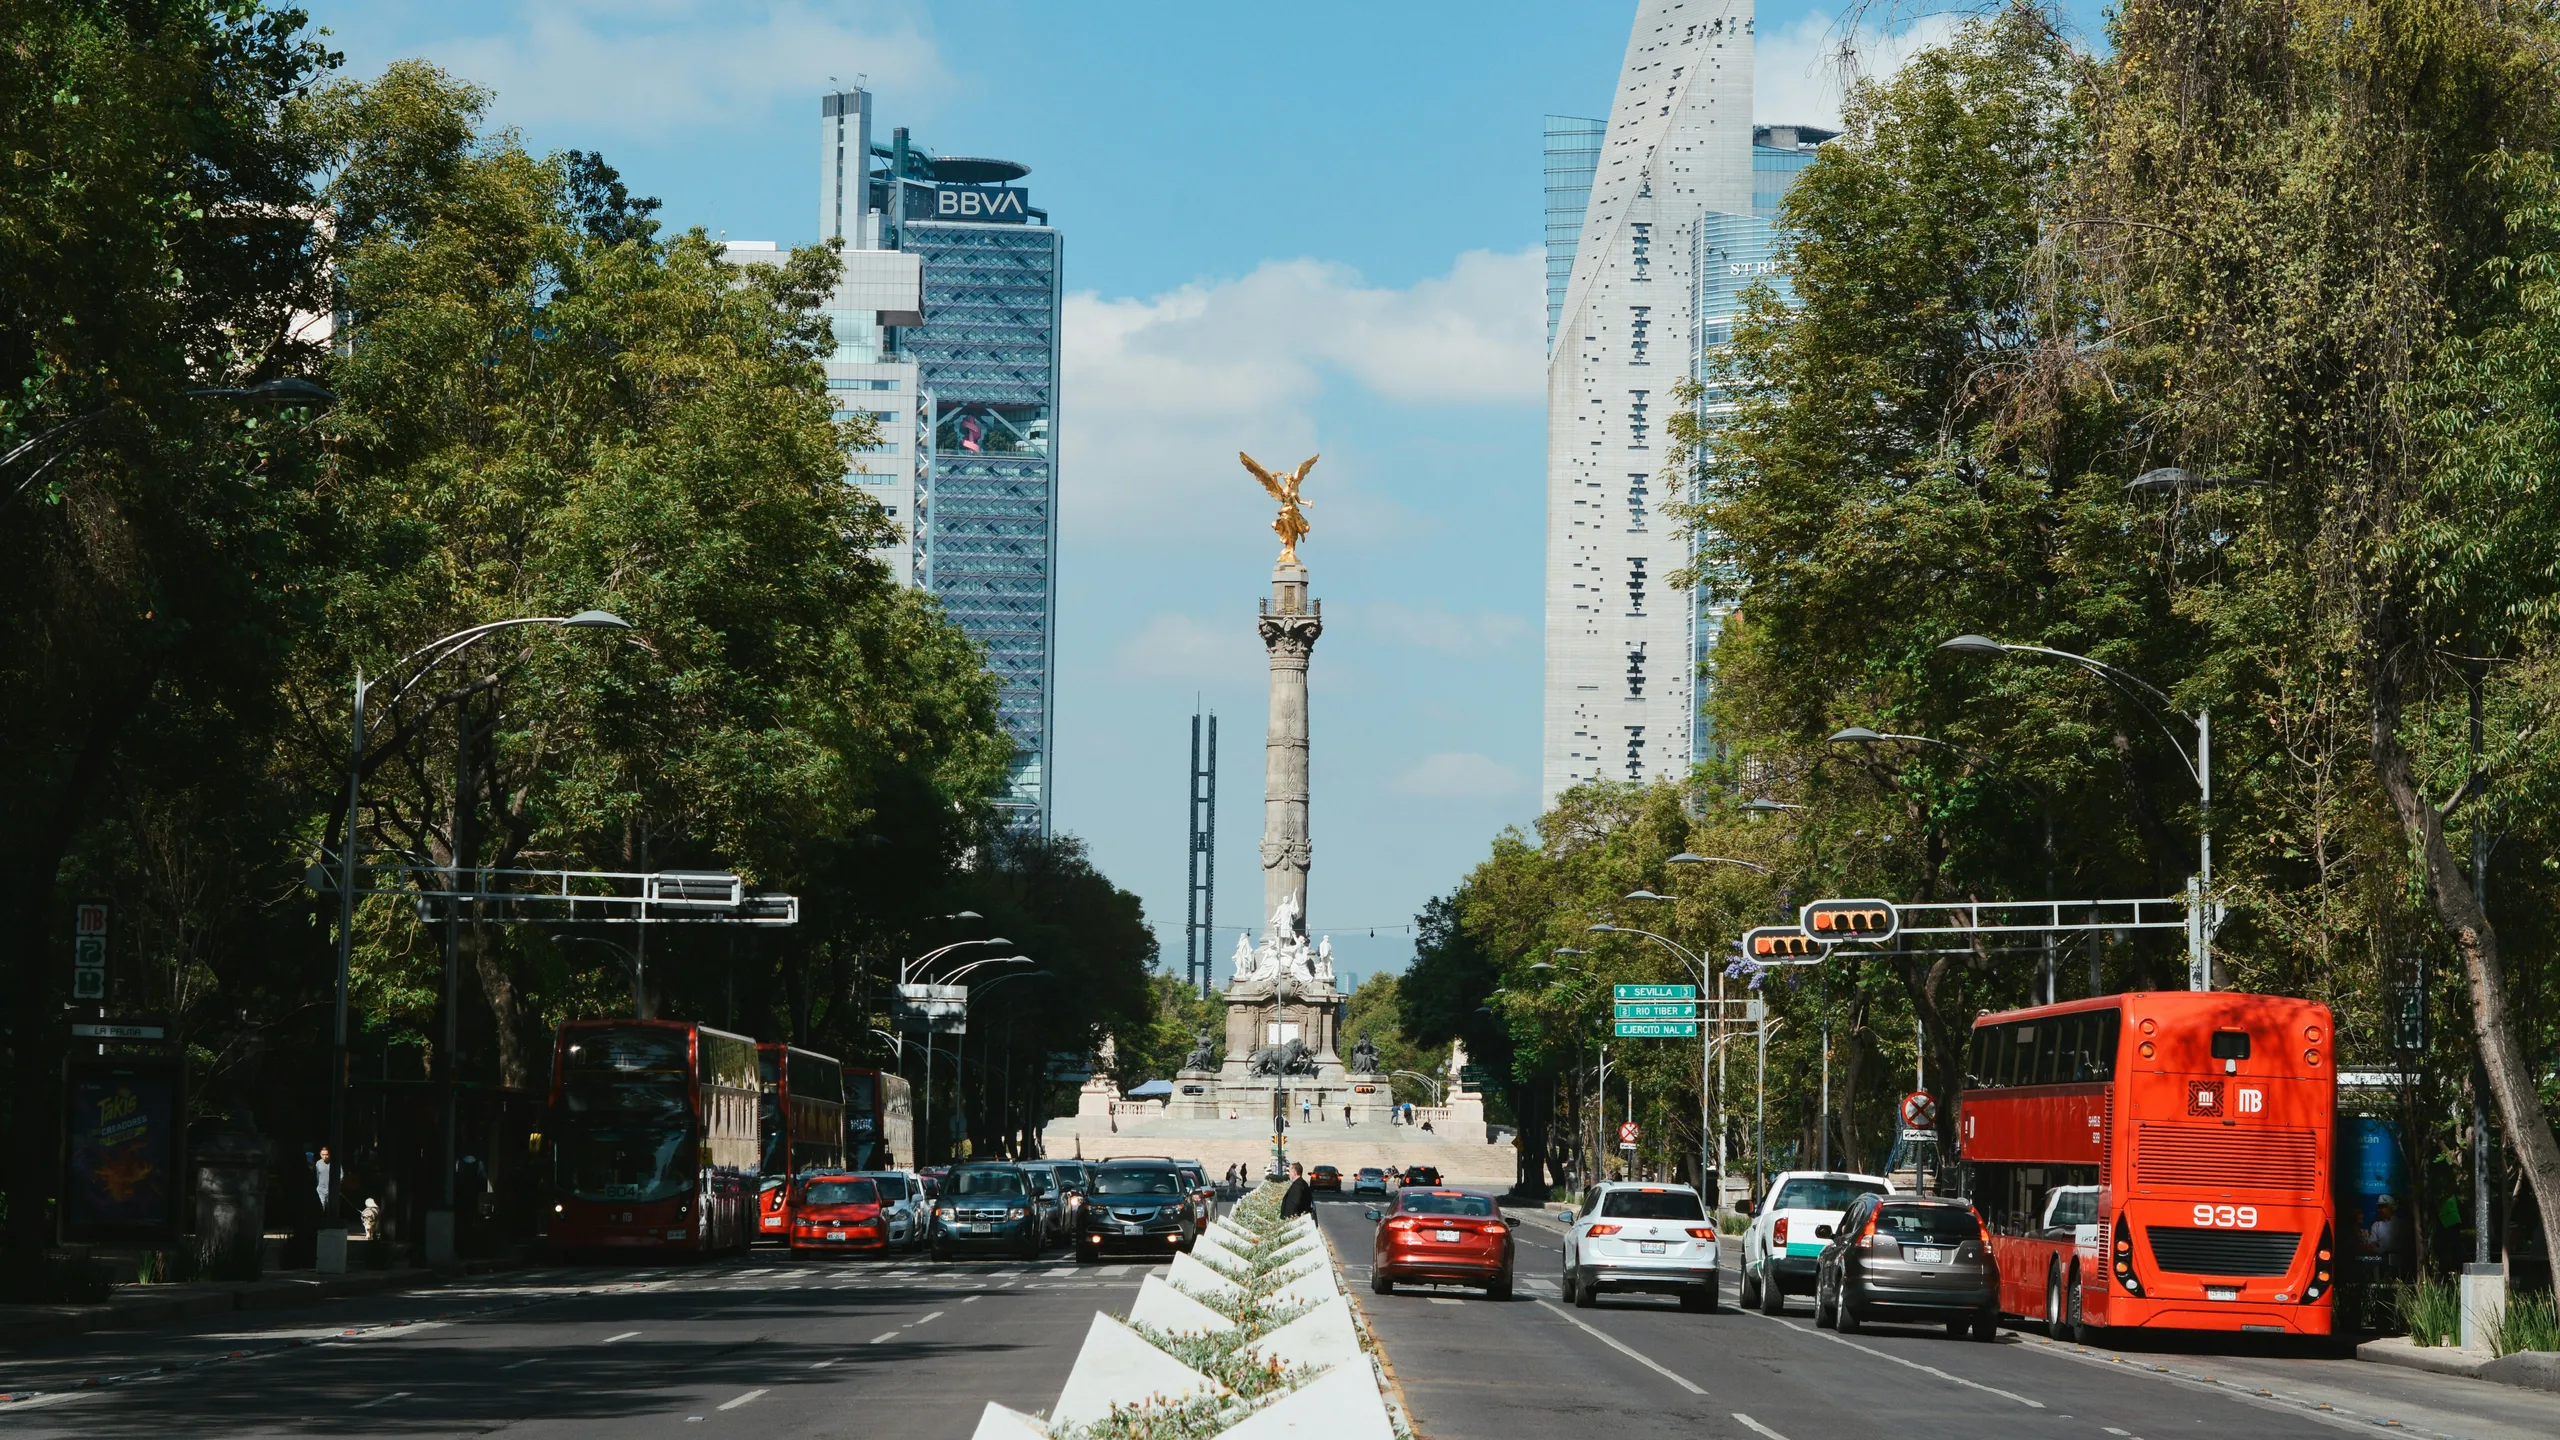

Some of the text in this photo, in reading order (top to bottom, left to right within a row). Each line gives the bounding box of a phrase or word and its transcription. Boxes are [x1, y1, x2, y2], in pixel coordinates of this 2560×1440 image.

[939, 190, 1024, 216] BBVA
[1634, 988, 1673, 997] SEVILLA
[1636, 1007, 1650, 1016] RIO
[1654, 1007, 1678, 1016] TIBER
[95, 1027, 141, 1036] LA PALMA
[1622, 1025, 1681, 1035] EJERCITO NAL
[96, 1093, 138, 1127] Takis
[2239, 1089, 2263, 1113] MB
[101, 1115, 148, 1136] CREADORES
[2193, 1204, 2258, 1229] 939
